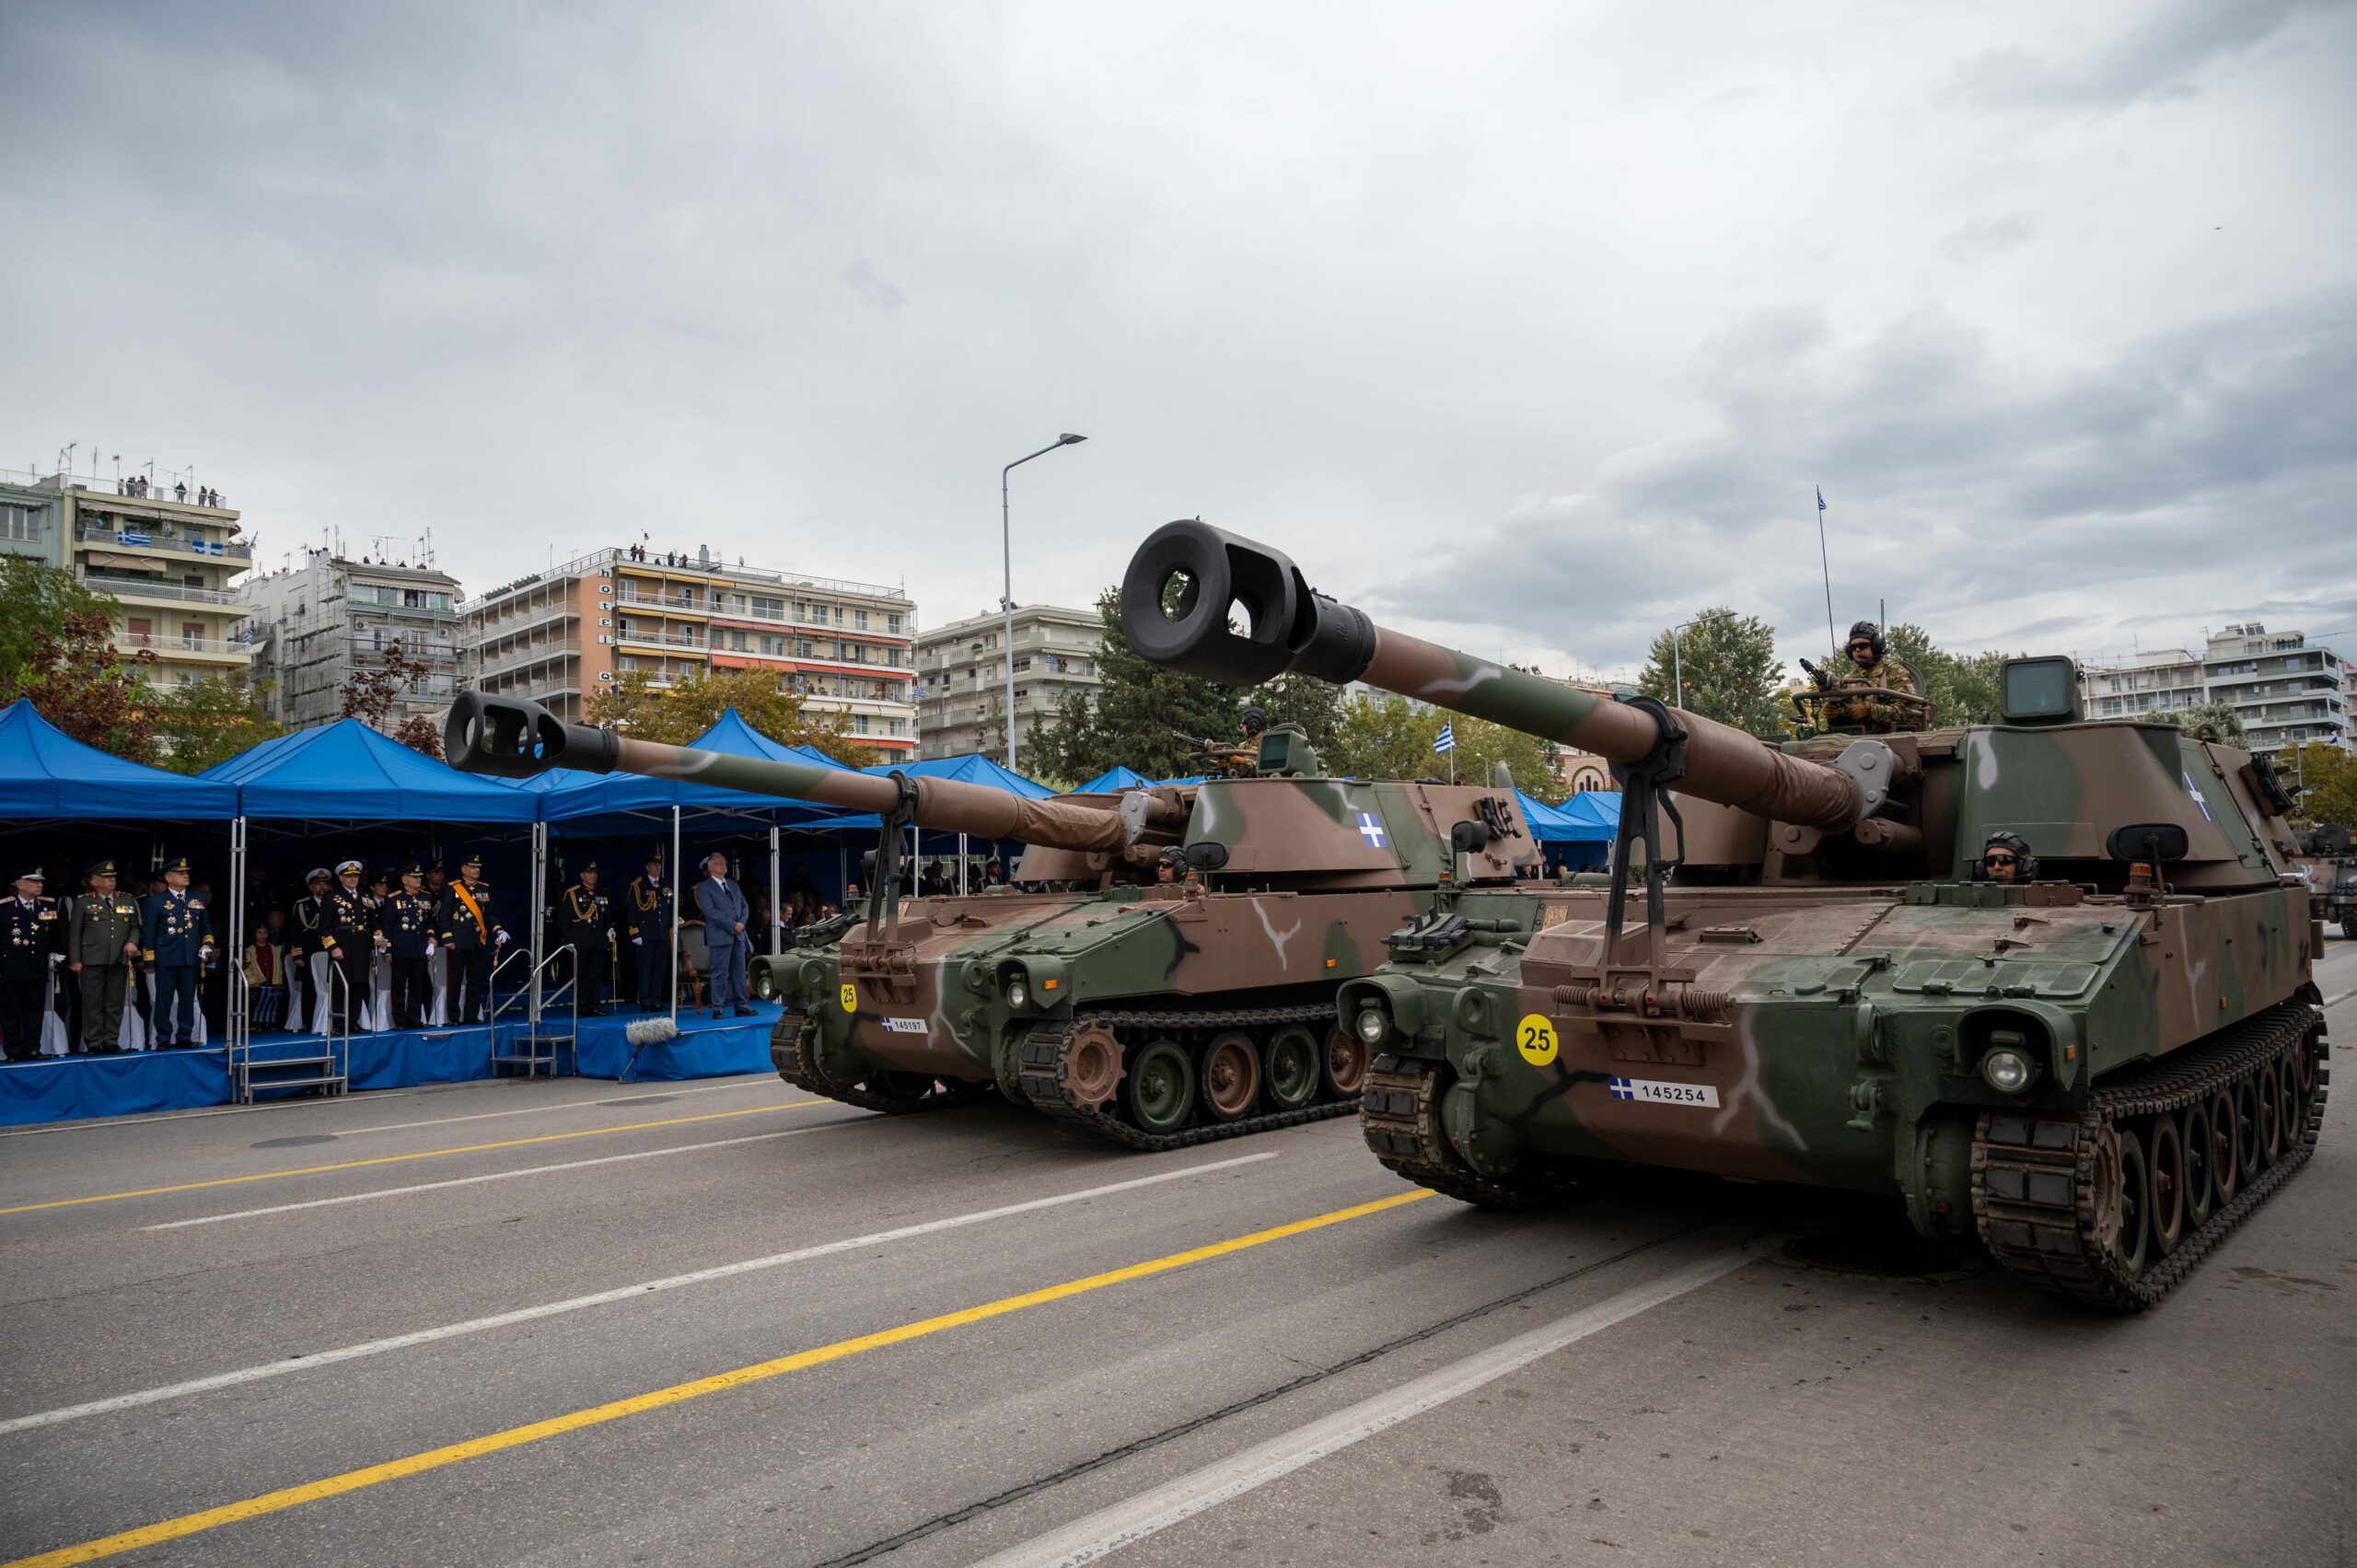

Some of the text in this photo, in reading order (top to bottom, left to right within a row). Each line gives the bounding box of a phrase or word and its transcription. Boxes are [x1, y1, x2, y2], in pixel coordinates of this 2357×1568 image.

[843, 988, 853, 1003] 25
[895, 1021, 922, 1030] 145197
[1524, 1027, 1550, 1051] 25
[1642, 1085, 1705, 1103] 145254
